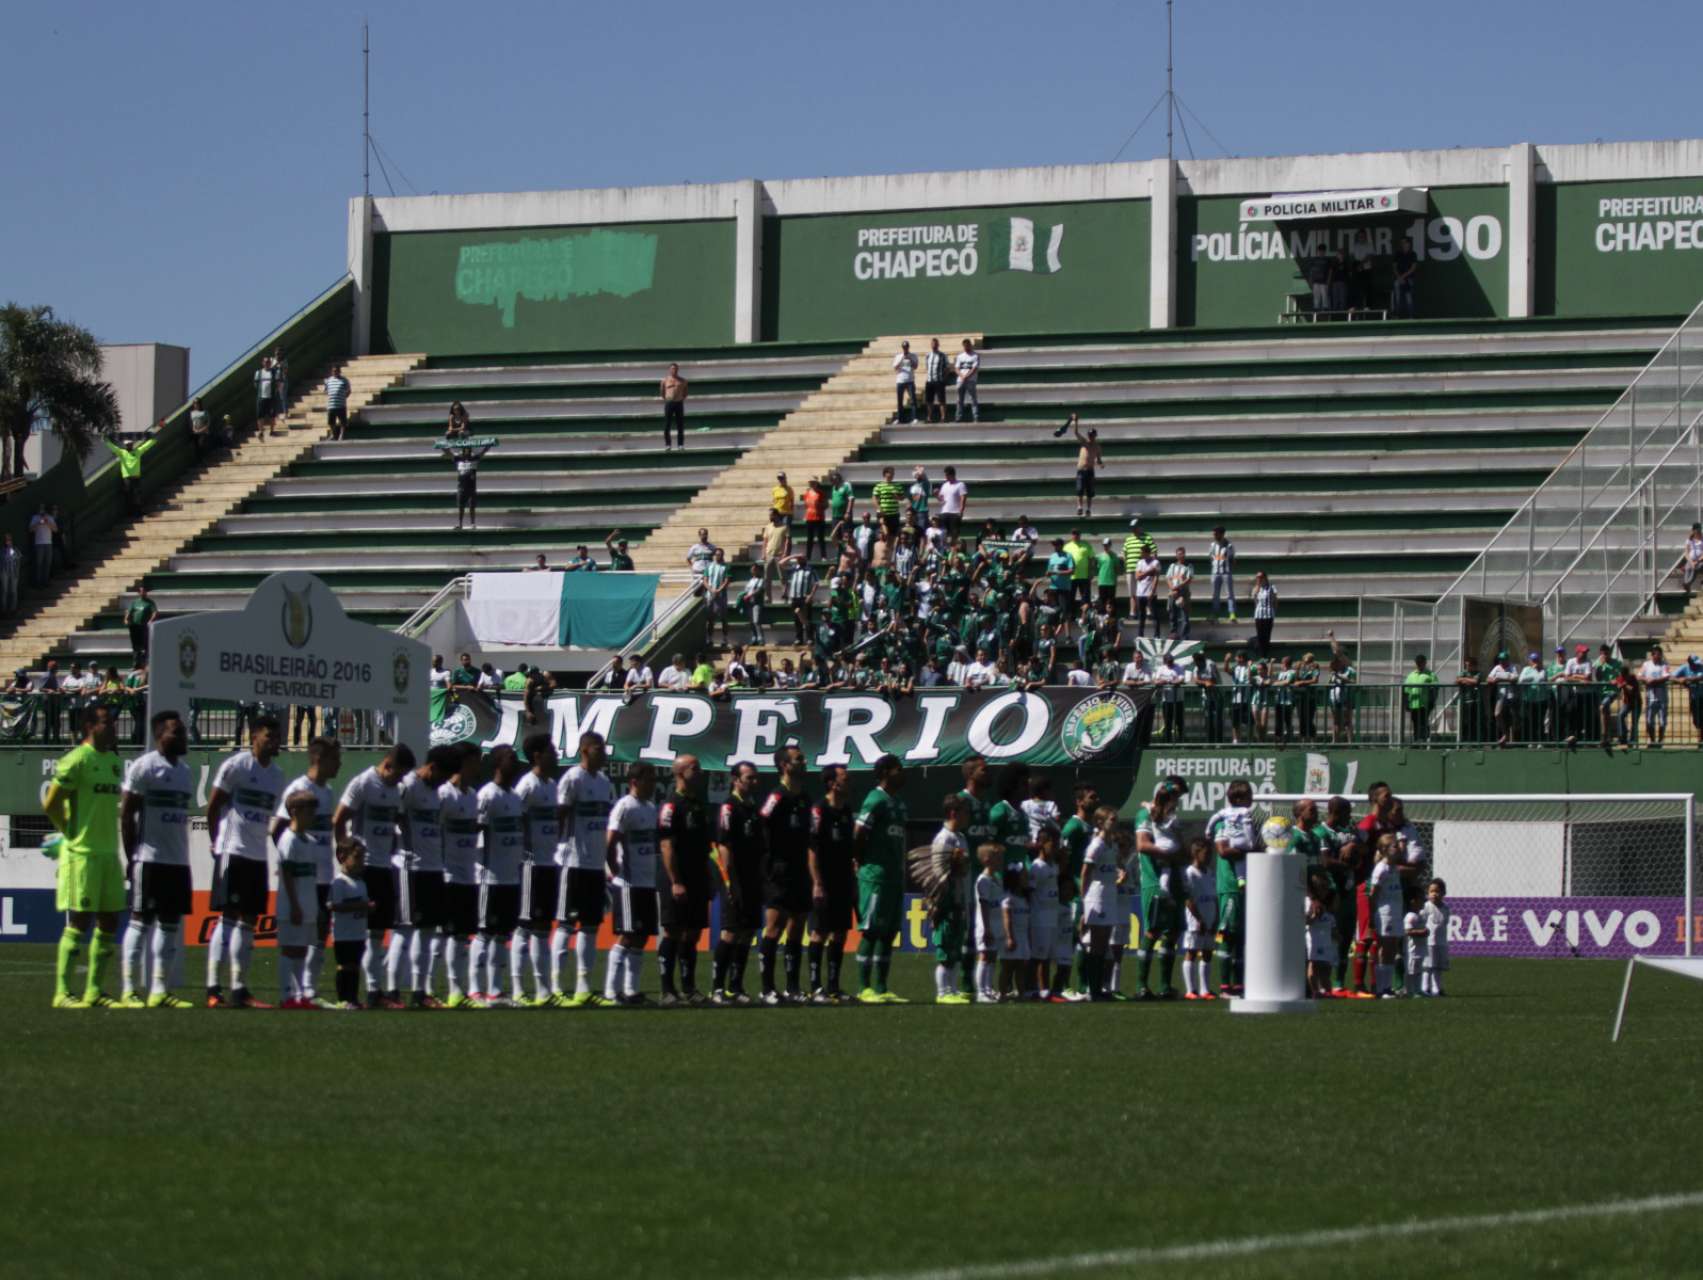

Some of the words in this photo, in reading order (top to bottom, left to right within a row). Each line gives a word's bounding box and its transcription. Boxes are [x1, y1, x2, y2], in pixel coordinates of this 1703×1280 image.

[1264, 201, 1317, 216] POLÍCIA
[1321, 197, 1375, 213] MILITAR
[857, 225, 954, 248] PREFEITURA
[957, 223, 979, 243] DE
[1191, 222, 1287, 262] POLÍCIA
[1406, 214, 1502, 261] 190
[853, 242, 979, 280] CHAPECÓ
[219, 652, 328, 680] BRASILEIRÃO
[333, 660, 372, 683] 2016
[254, 678, 338, 700] CHEVROLET
[1155, 757, 1250, 776] PREFEITURA
[1254, 758, 1277, 776] DE
[1491, 907, 1509, 942] É
[1521, 909, 1662, 949] VIVO
